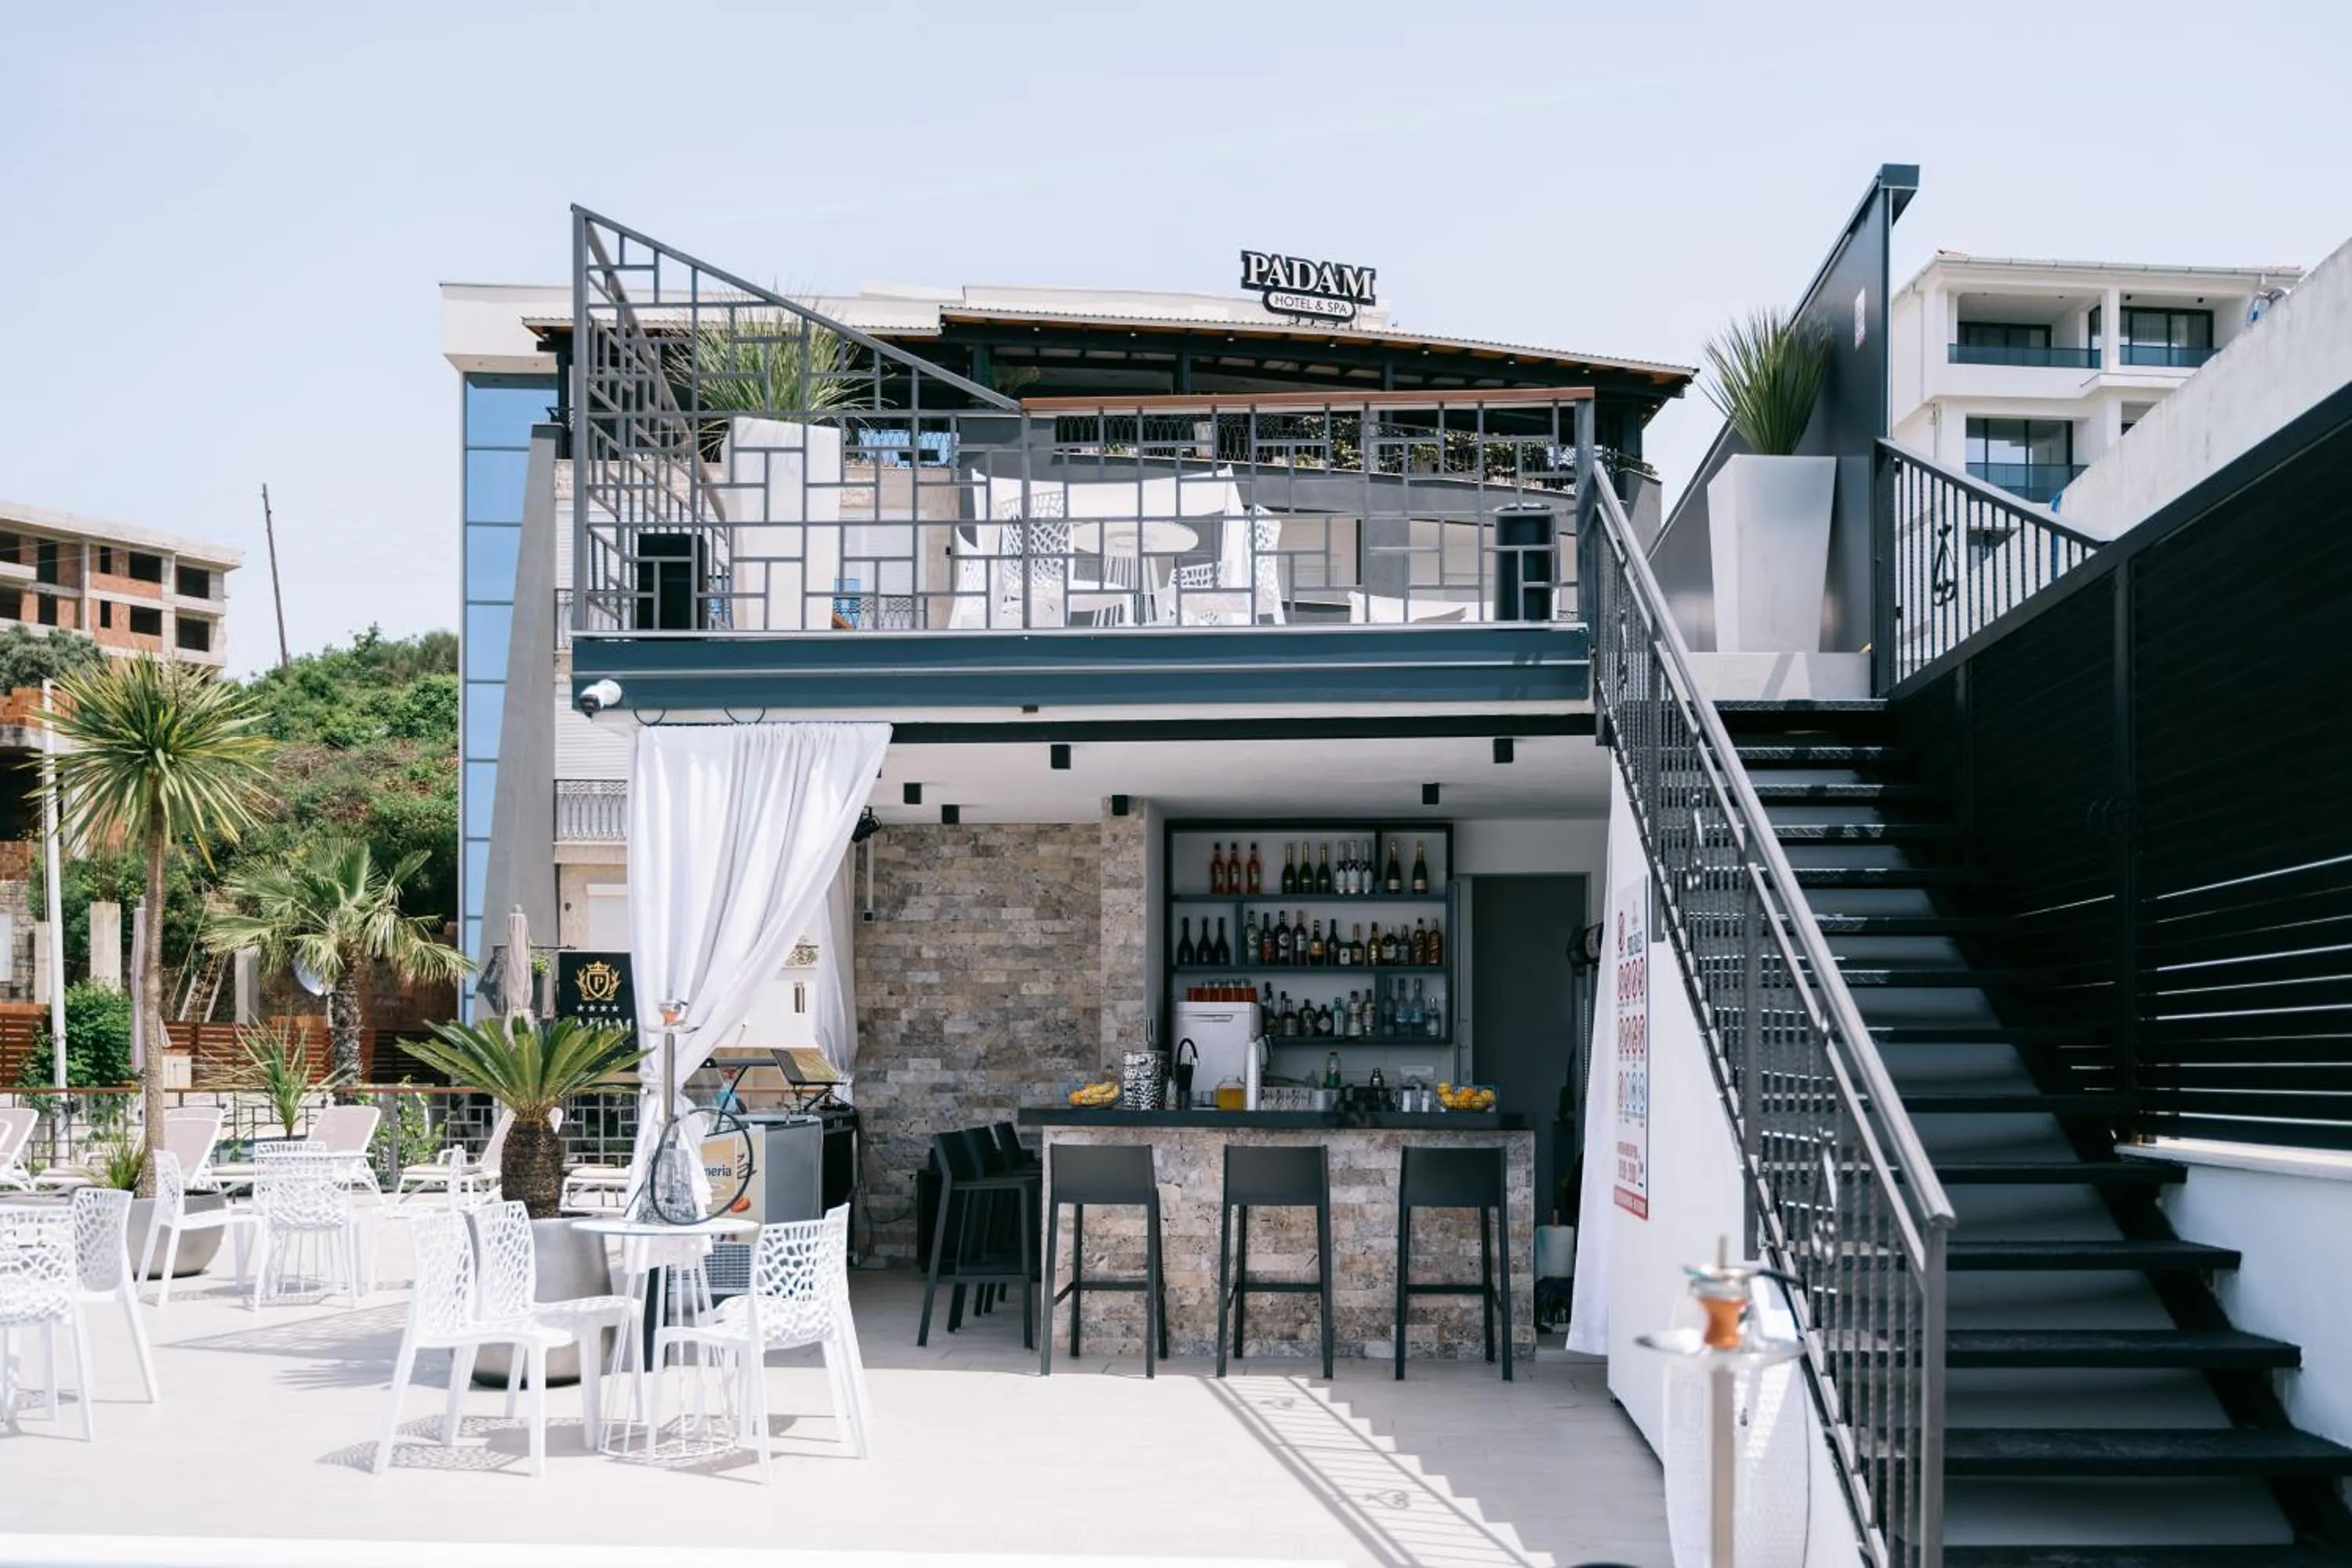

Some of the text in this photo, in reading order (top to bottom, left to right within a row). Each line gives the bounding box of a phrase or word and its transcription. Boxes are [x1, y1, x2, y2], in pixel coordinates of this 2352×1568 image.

[1243, 251, 1374, 303] PADAM
[1274, 294, 1348, 315] HOTEL & SPA
[593, 976, 604, 990] P
